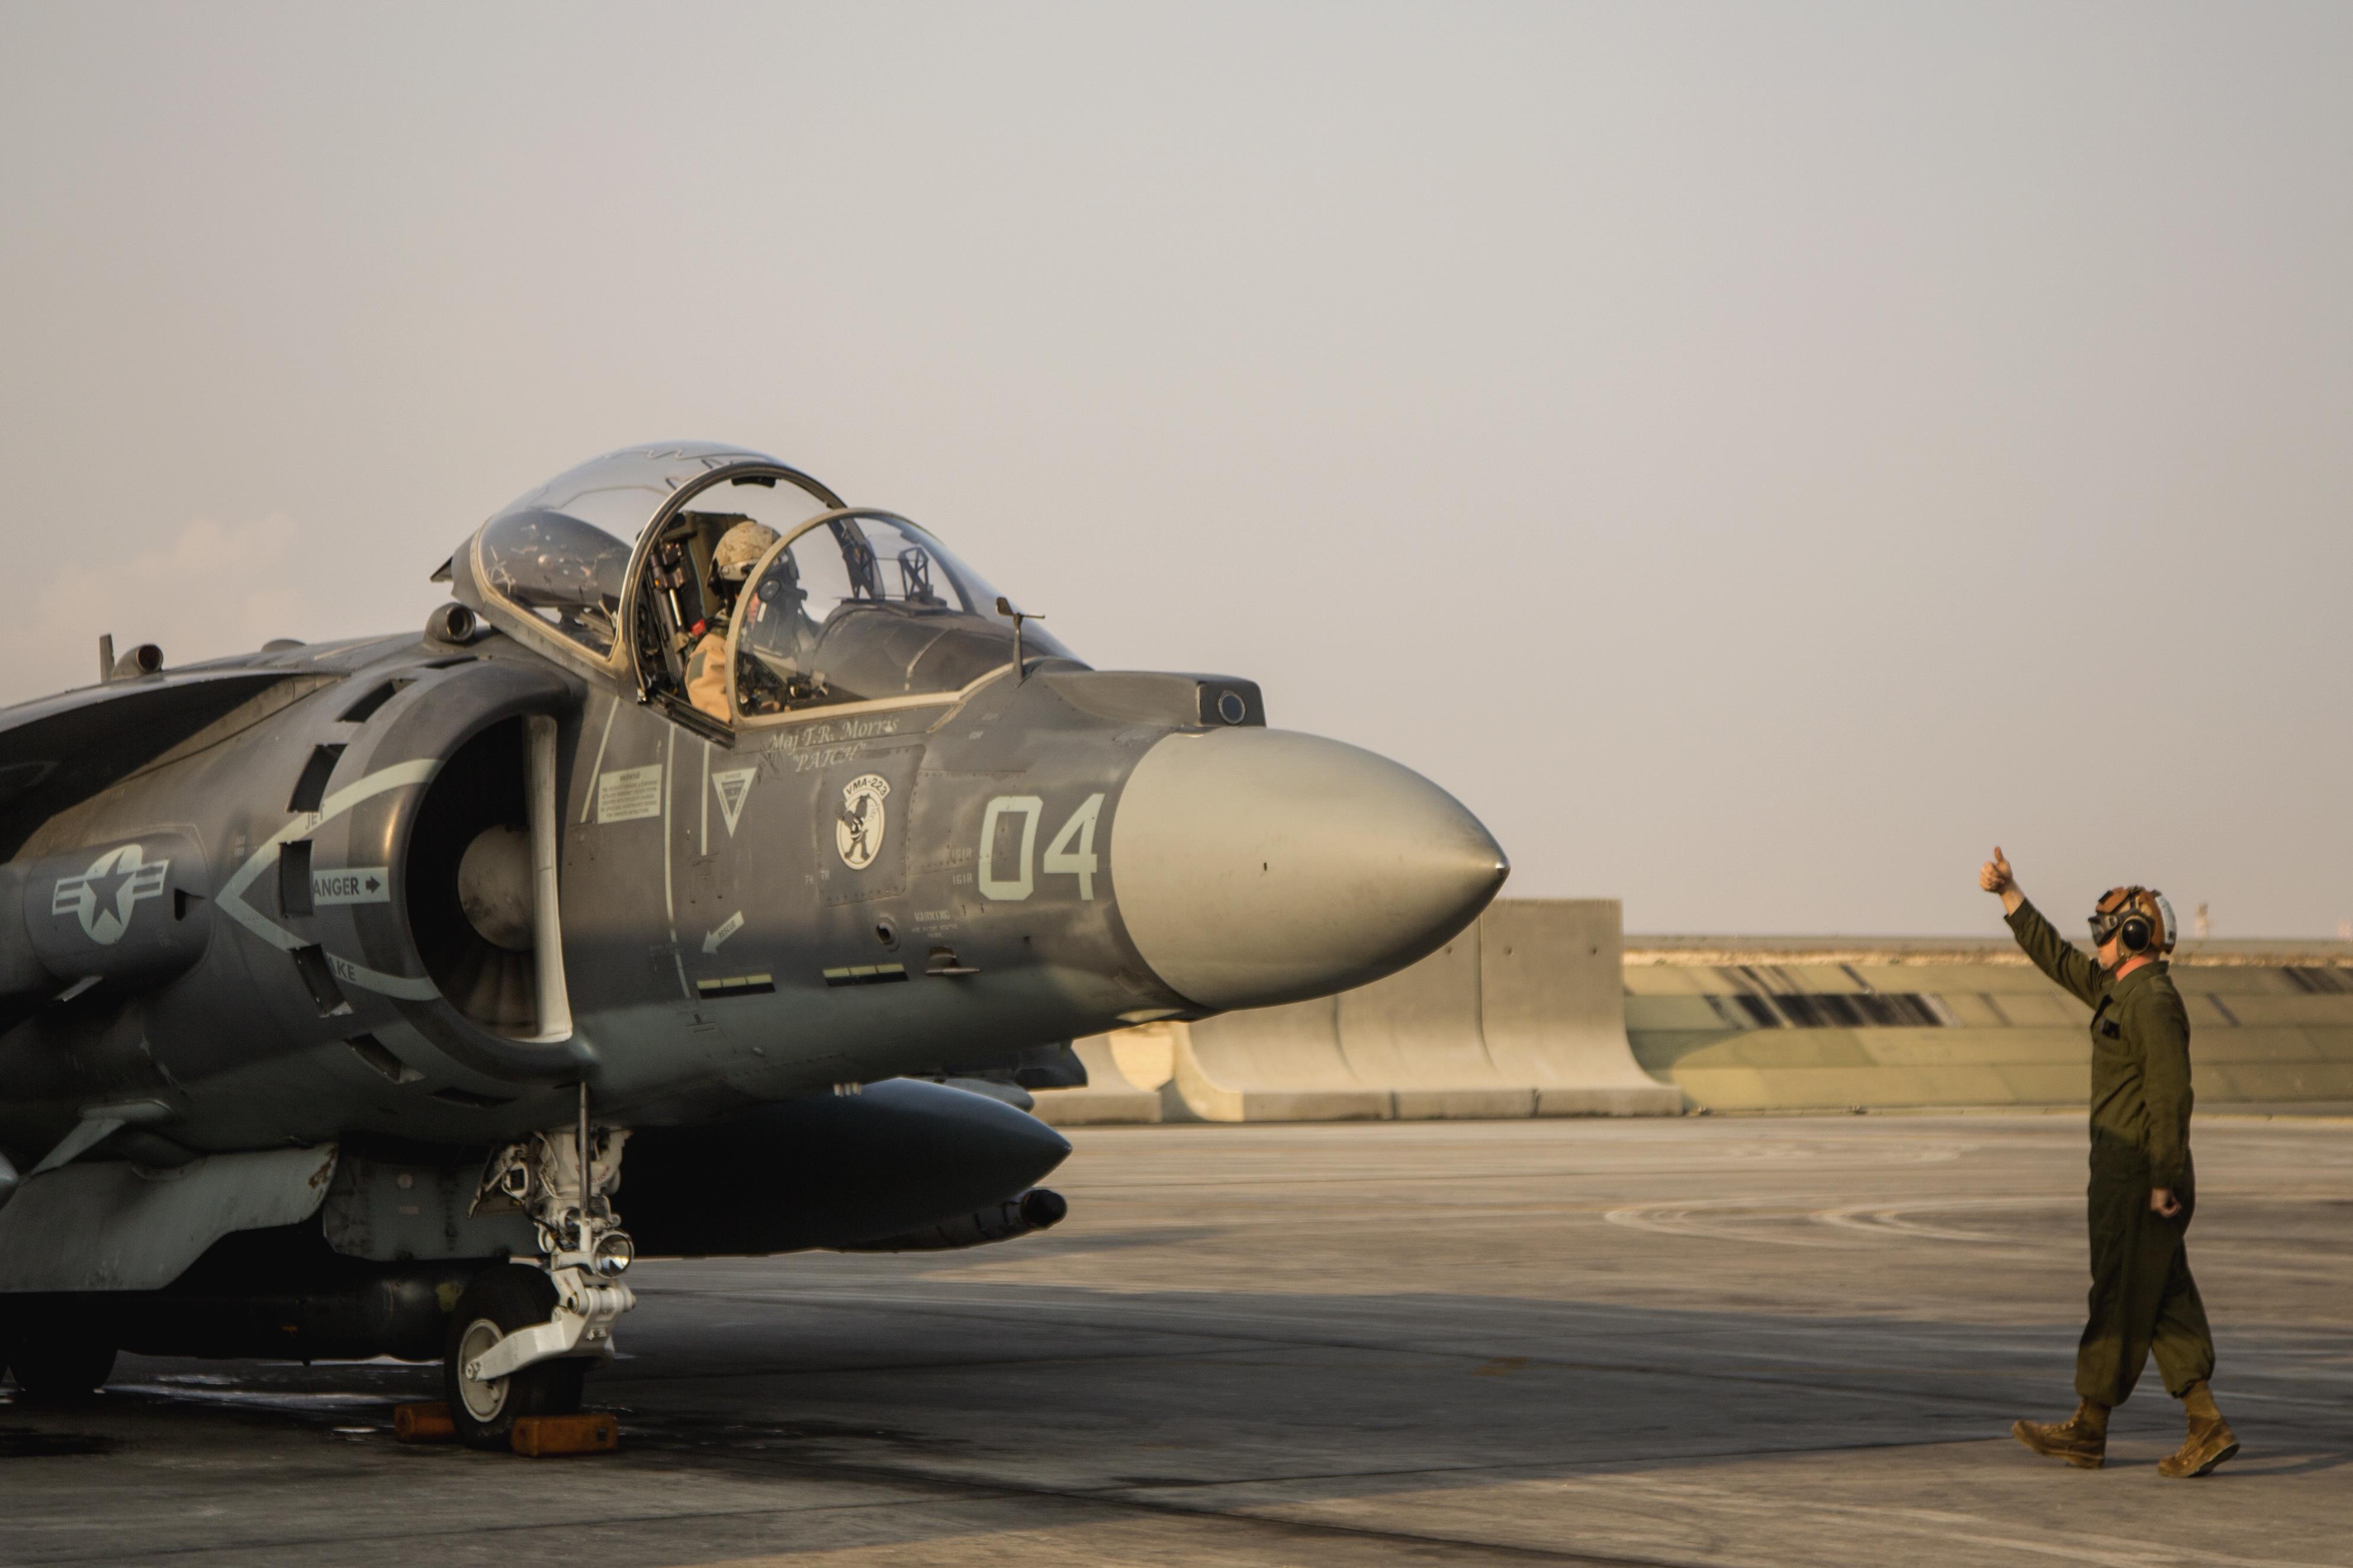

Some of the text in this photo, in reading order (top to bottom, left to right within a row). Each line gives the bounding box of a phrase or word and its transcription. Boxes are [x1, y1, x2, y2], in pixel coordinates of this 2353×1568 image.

[768, 730, 799, 756] Maj
[840, 716, 900, 739] Morris
[846, 777, 887, 796] VMA-223
[979, 793, 1105, 901] 04
[718, 919, 736, 939] RESCUE
